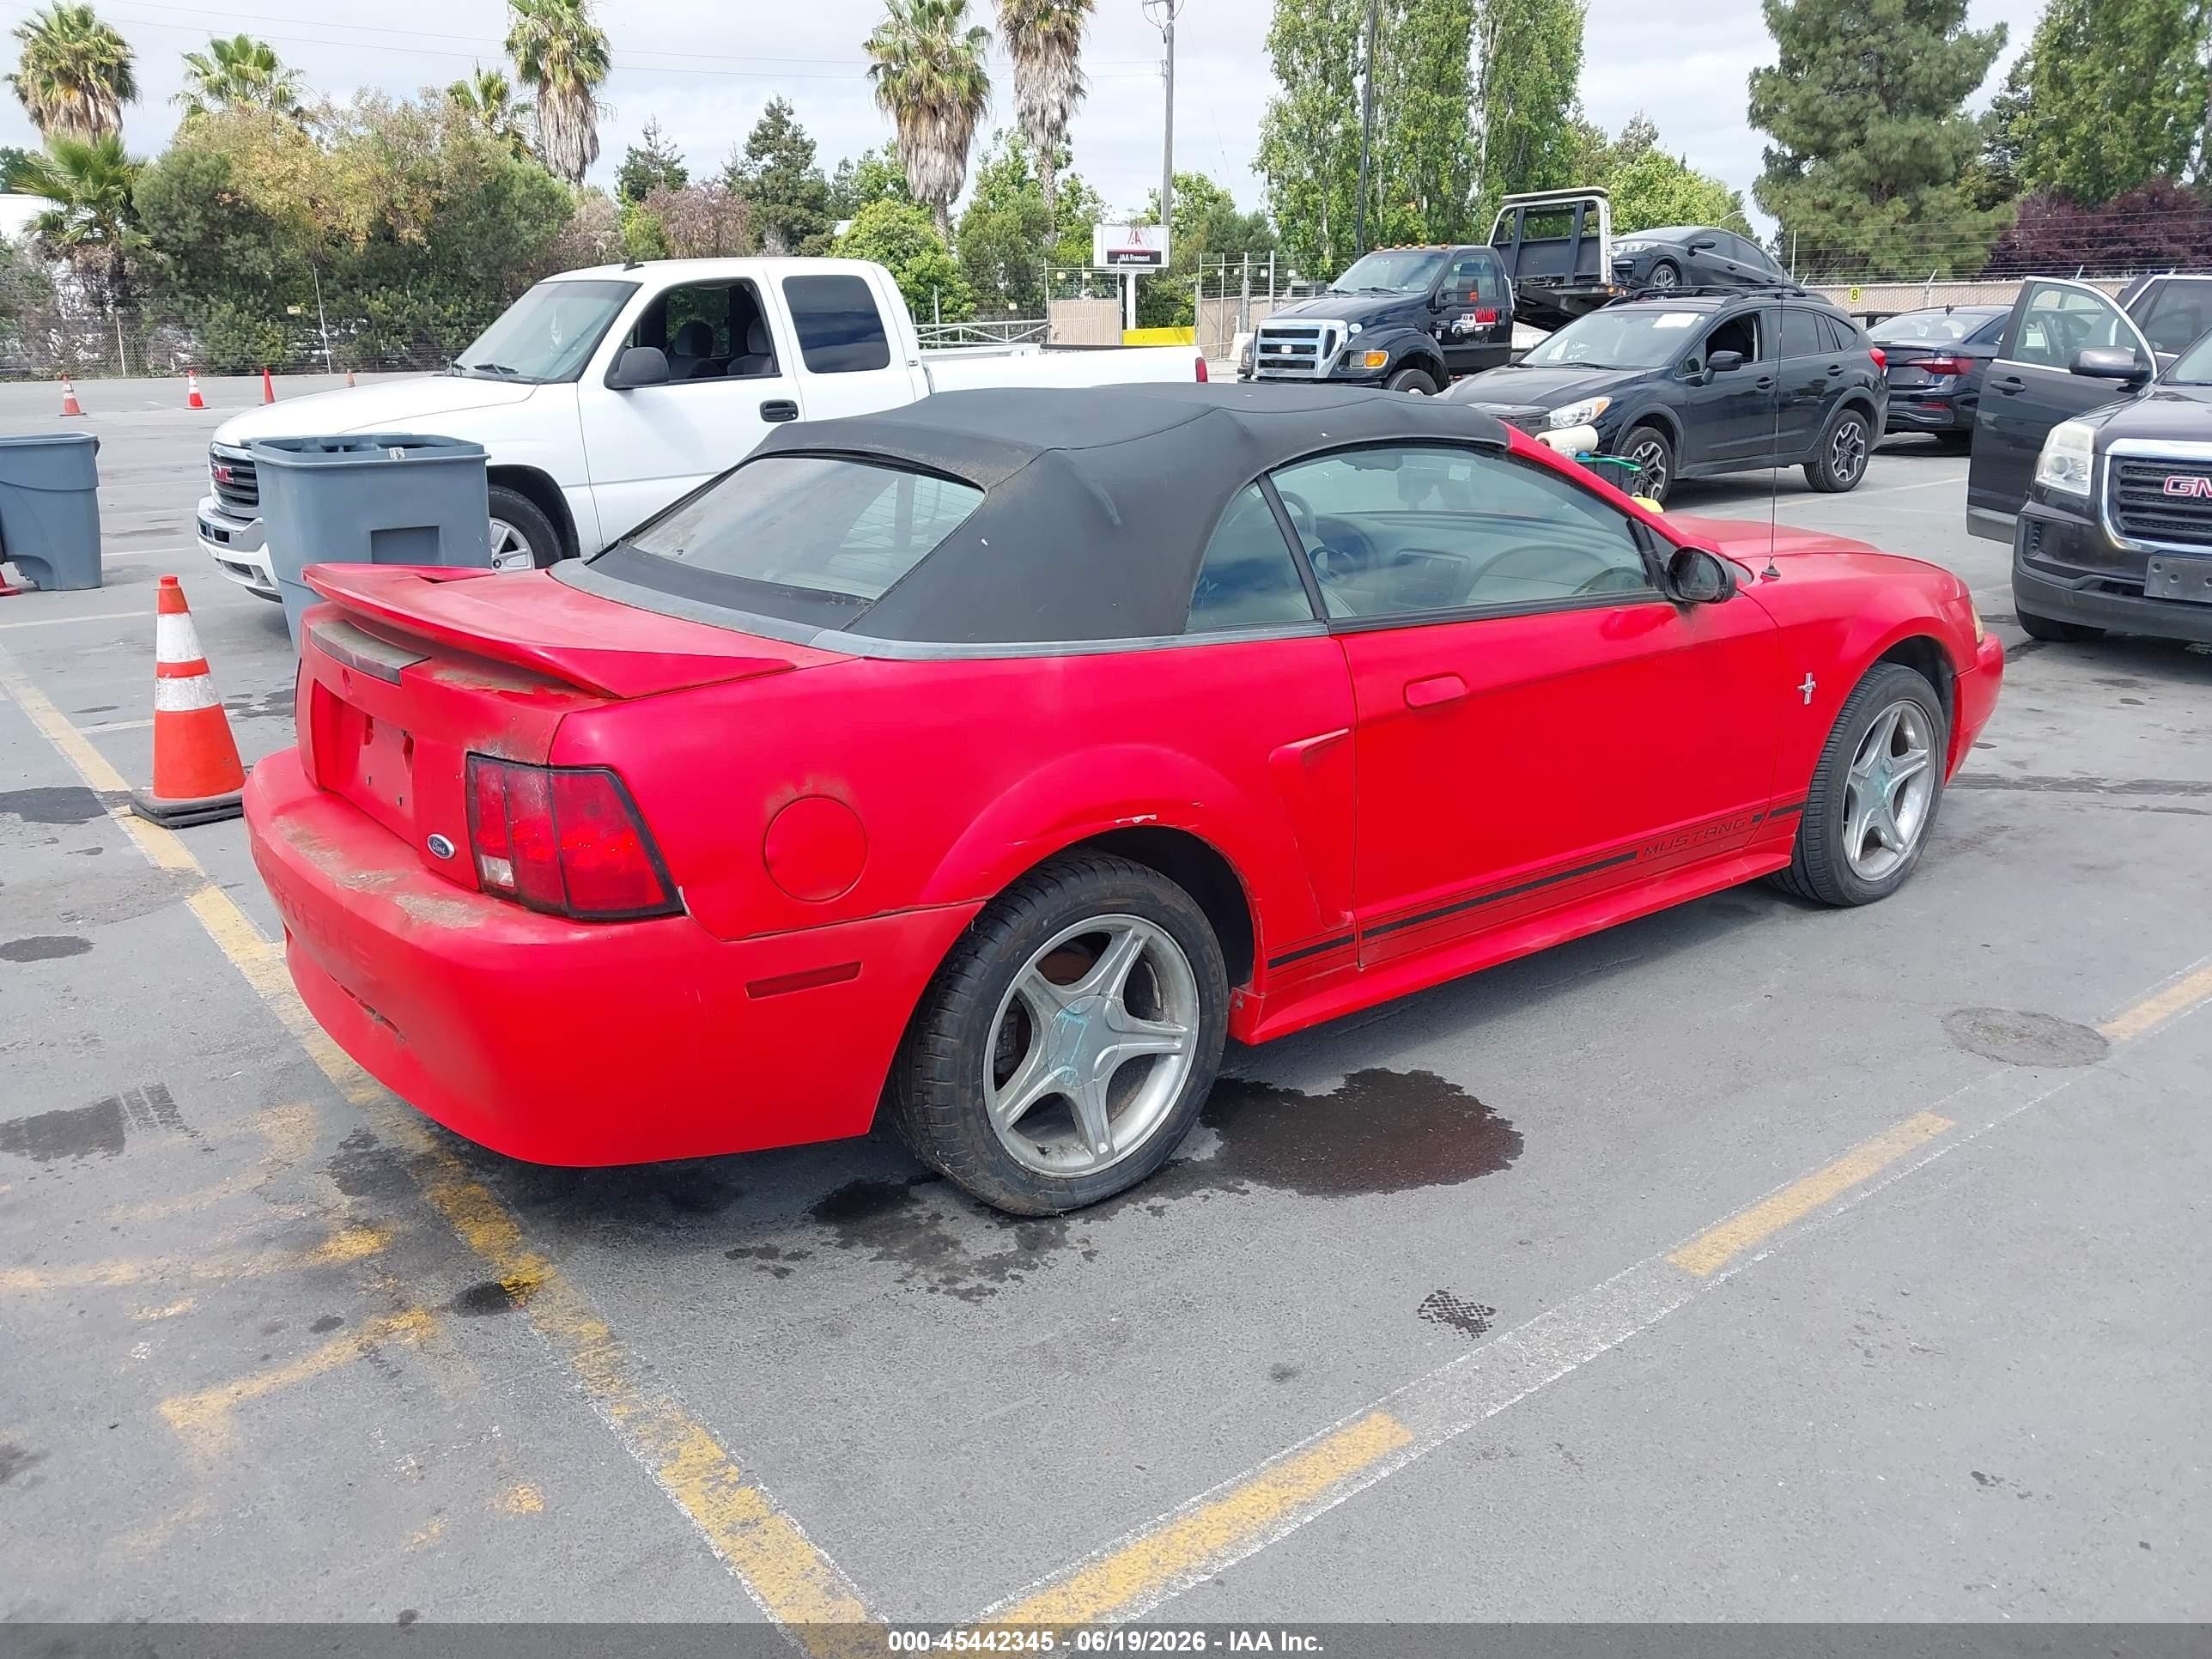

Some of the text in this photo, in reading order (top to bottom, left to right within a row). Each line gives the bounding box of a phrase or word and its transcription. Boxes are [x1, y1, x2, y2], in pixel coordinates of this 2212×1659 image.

[1851, 289, 1858, 300] 8
[1475, 307, 1497, 323] ROJAS
[1643, 817, 1747, 857] MUSTANG
